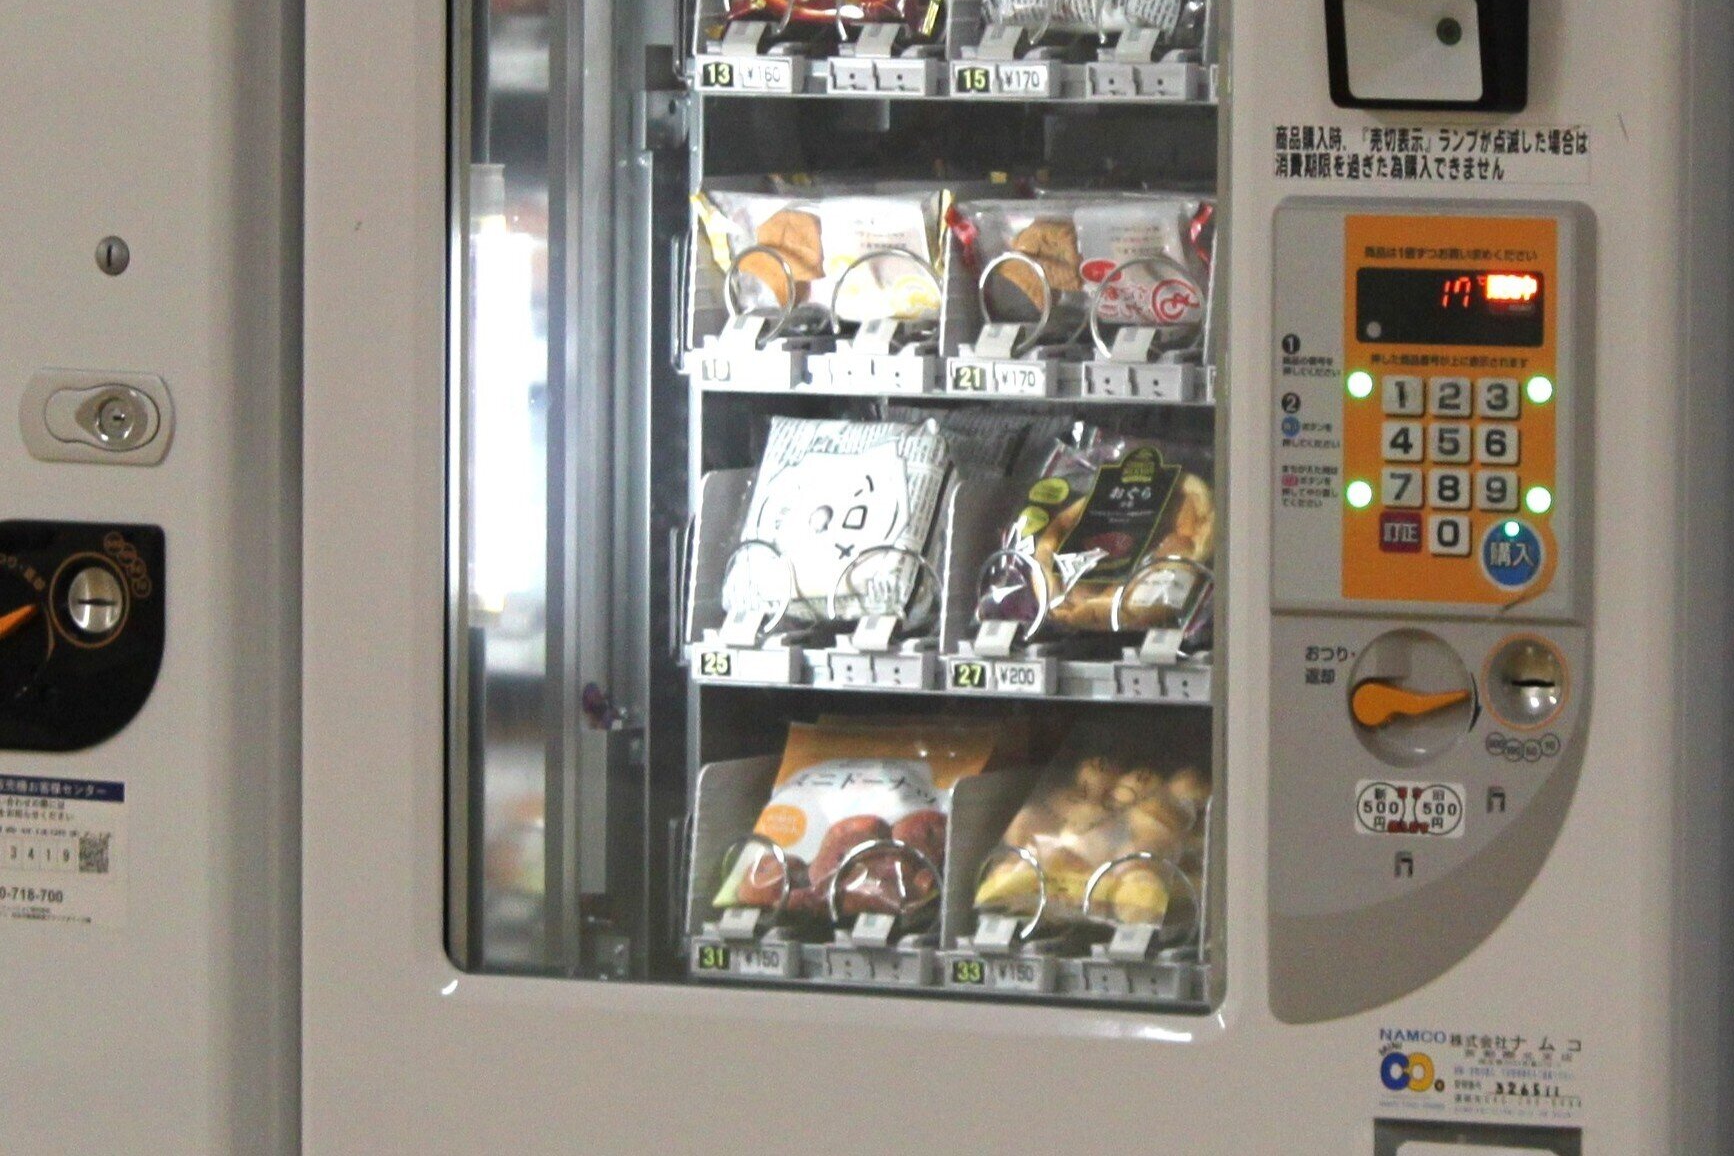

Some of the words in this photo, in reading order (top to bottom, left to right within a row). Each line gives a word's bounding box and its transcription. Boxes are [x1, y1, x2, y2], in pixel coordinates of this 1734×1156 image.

[707, 63, 731, 86] 13
[963, 68, 986, 91] 15
[1004, 70, 1040, 89] ¥170
[955, 365, 980, 390] 21
[1001, 368, 1036, 387] ¥170
[1394, 380, 1407, 407] 1
[1438, 382, 1461, 409] 2
[1486, 384, 1509, 411] 3
[1389, 427, 1413, 455] 4
[1437, 428, 1461, 456] 5
[1485, 429, 1508, 458] 6
[1389, 473, 1413, 501] 7
[1437, 474, 1461, 502] 8
[1485, 476, 1508, 504] 9
[1384, 521, 1419, 545] 訂正
[1437, 519, 1460, 547] 0
[1489, 540, 1532, 568] 購入
[705, 653, 729, 676] 25
[960, 665, 982, 687] 27
[999, 668, 1035, 686] ¥200
[1305, 668, 1336, 686] 返却
[1363, 801, 1399, 815] 500
[1422, 802, 1457, 817] 500
[703, 946, 725, 967] 31
[957, 959, 981, 982] 33
[1379, 1028, 1447, 1044] NAMCO
